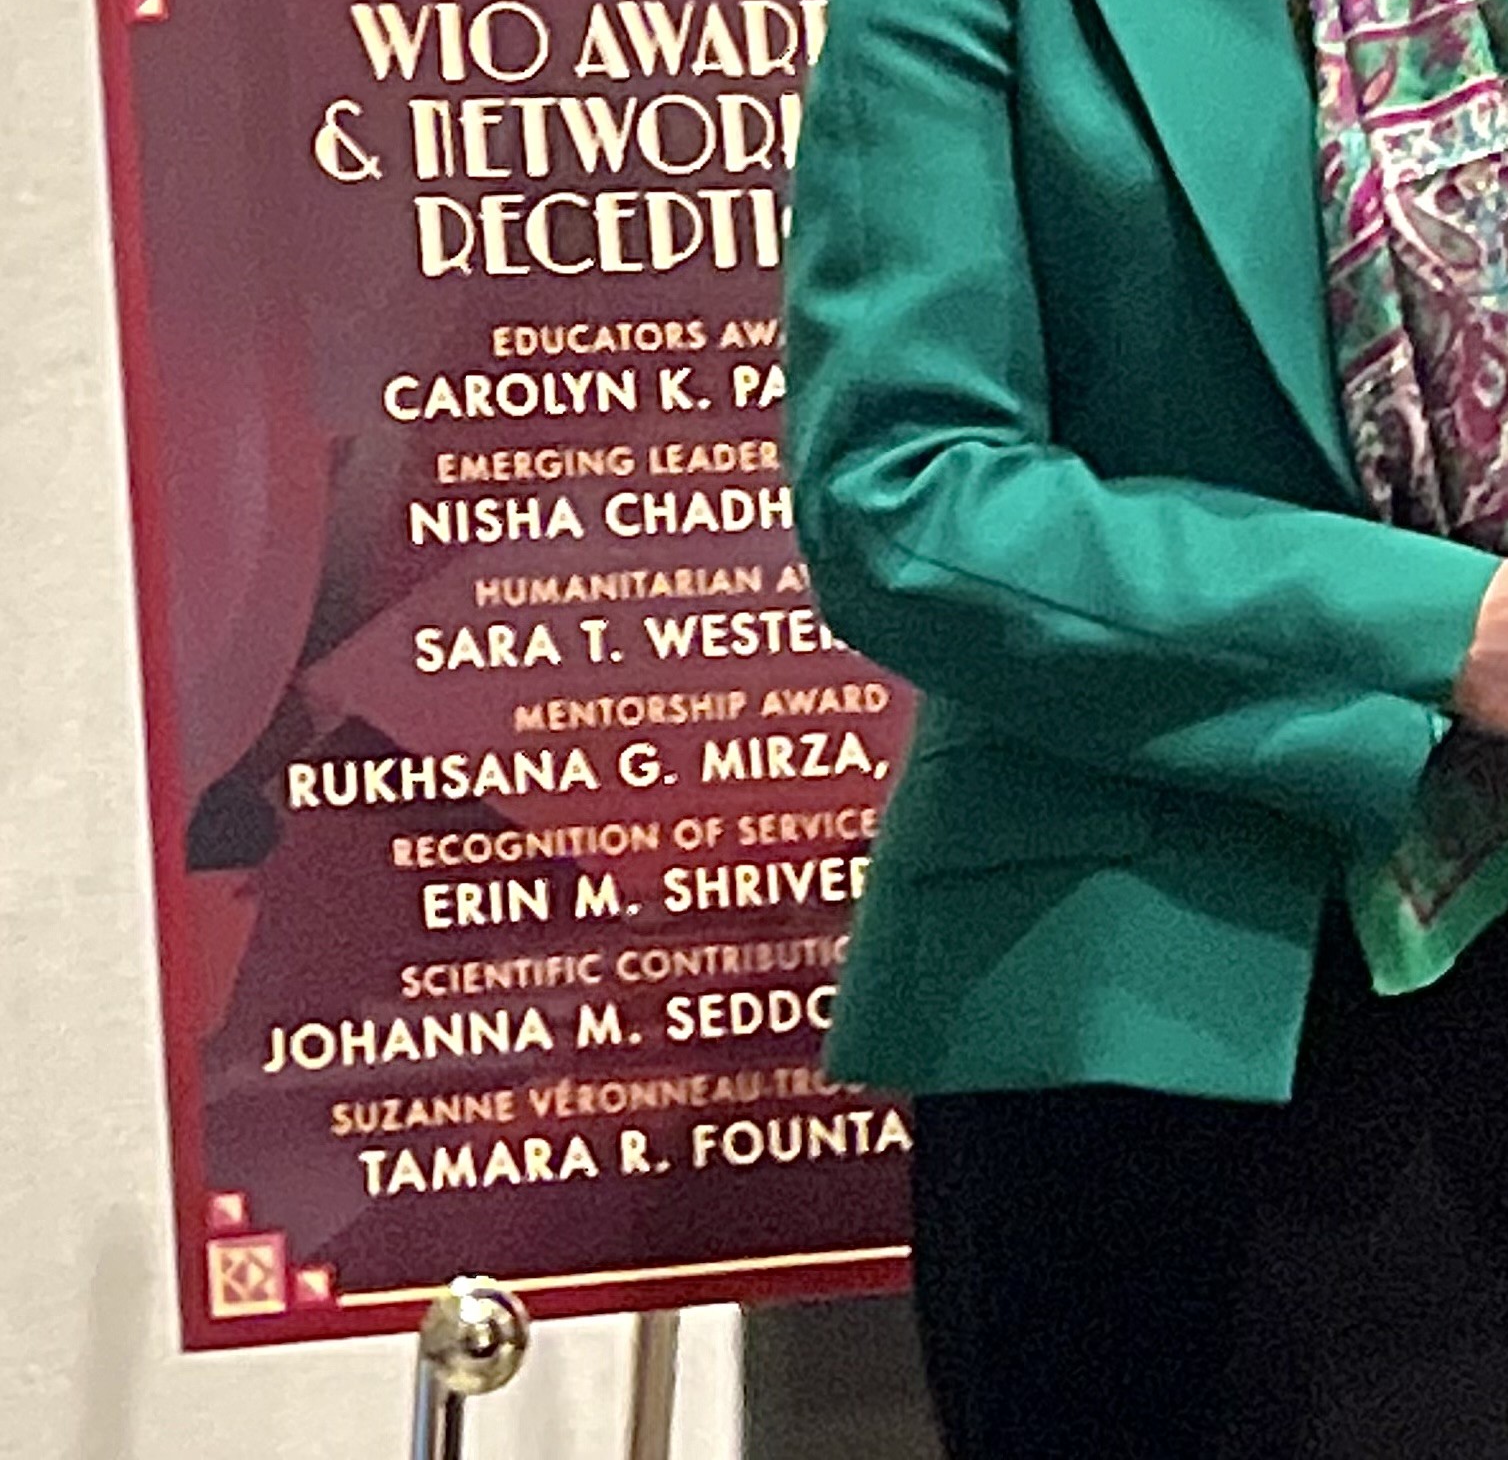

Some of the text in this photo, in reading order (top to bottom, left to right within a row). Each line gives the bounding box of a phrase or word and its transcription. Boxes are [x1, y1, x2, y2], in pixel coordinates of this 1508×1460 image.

[350, 1, 549, 82] WIO
[315, 99, 383, 181] &
[413, 188, 791, 277] RECEPTI
[493, 319, 786, 357] EDUCATORS AW
[384, 369, 637, 420] CAROLYN
[659, 367, 711, 411] K.
[437, 441, 781, 484] EMERGING LEADER
[410, 486, 793, 545] NISHA CHADH
[475, 566, 762, 607] HUMANITARIAN
[415, 609, 858, 672] SARA T. WESTE
[514, 683, 889, 732] MENTORSHIP AWARD
[288, 731, 889, 808] RUKHSANA G. MIRZA,
[392, 808, 881, 868] RECOGNITION OF SERVICE
[423, 878, 549, 929] ERIN
[574, 873, 640, 919] M.
[401, 953, 602, 998] SCIENTIFIC
[262, 1007, 554, 1073] JOHANNA
[577, 1003, 642, 1048] M.
[331, 1090, 515, 1136] SUZANNE
[357, 1109, 913, 1197] TAMARA R. FOUNTA
